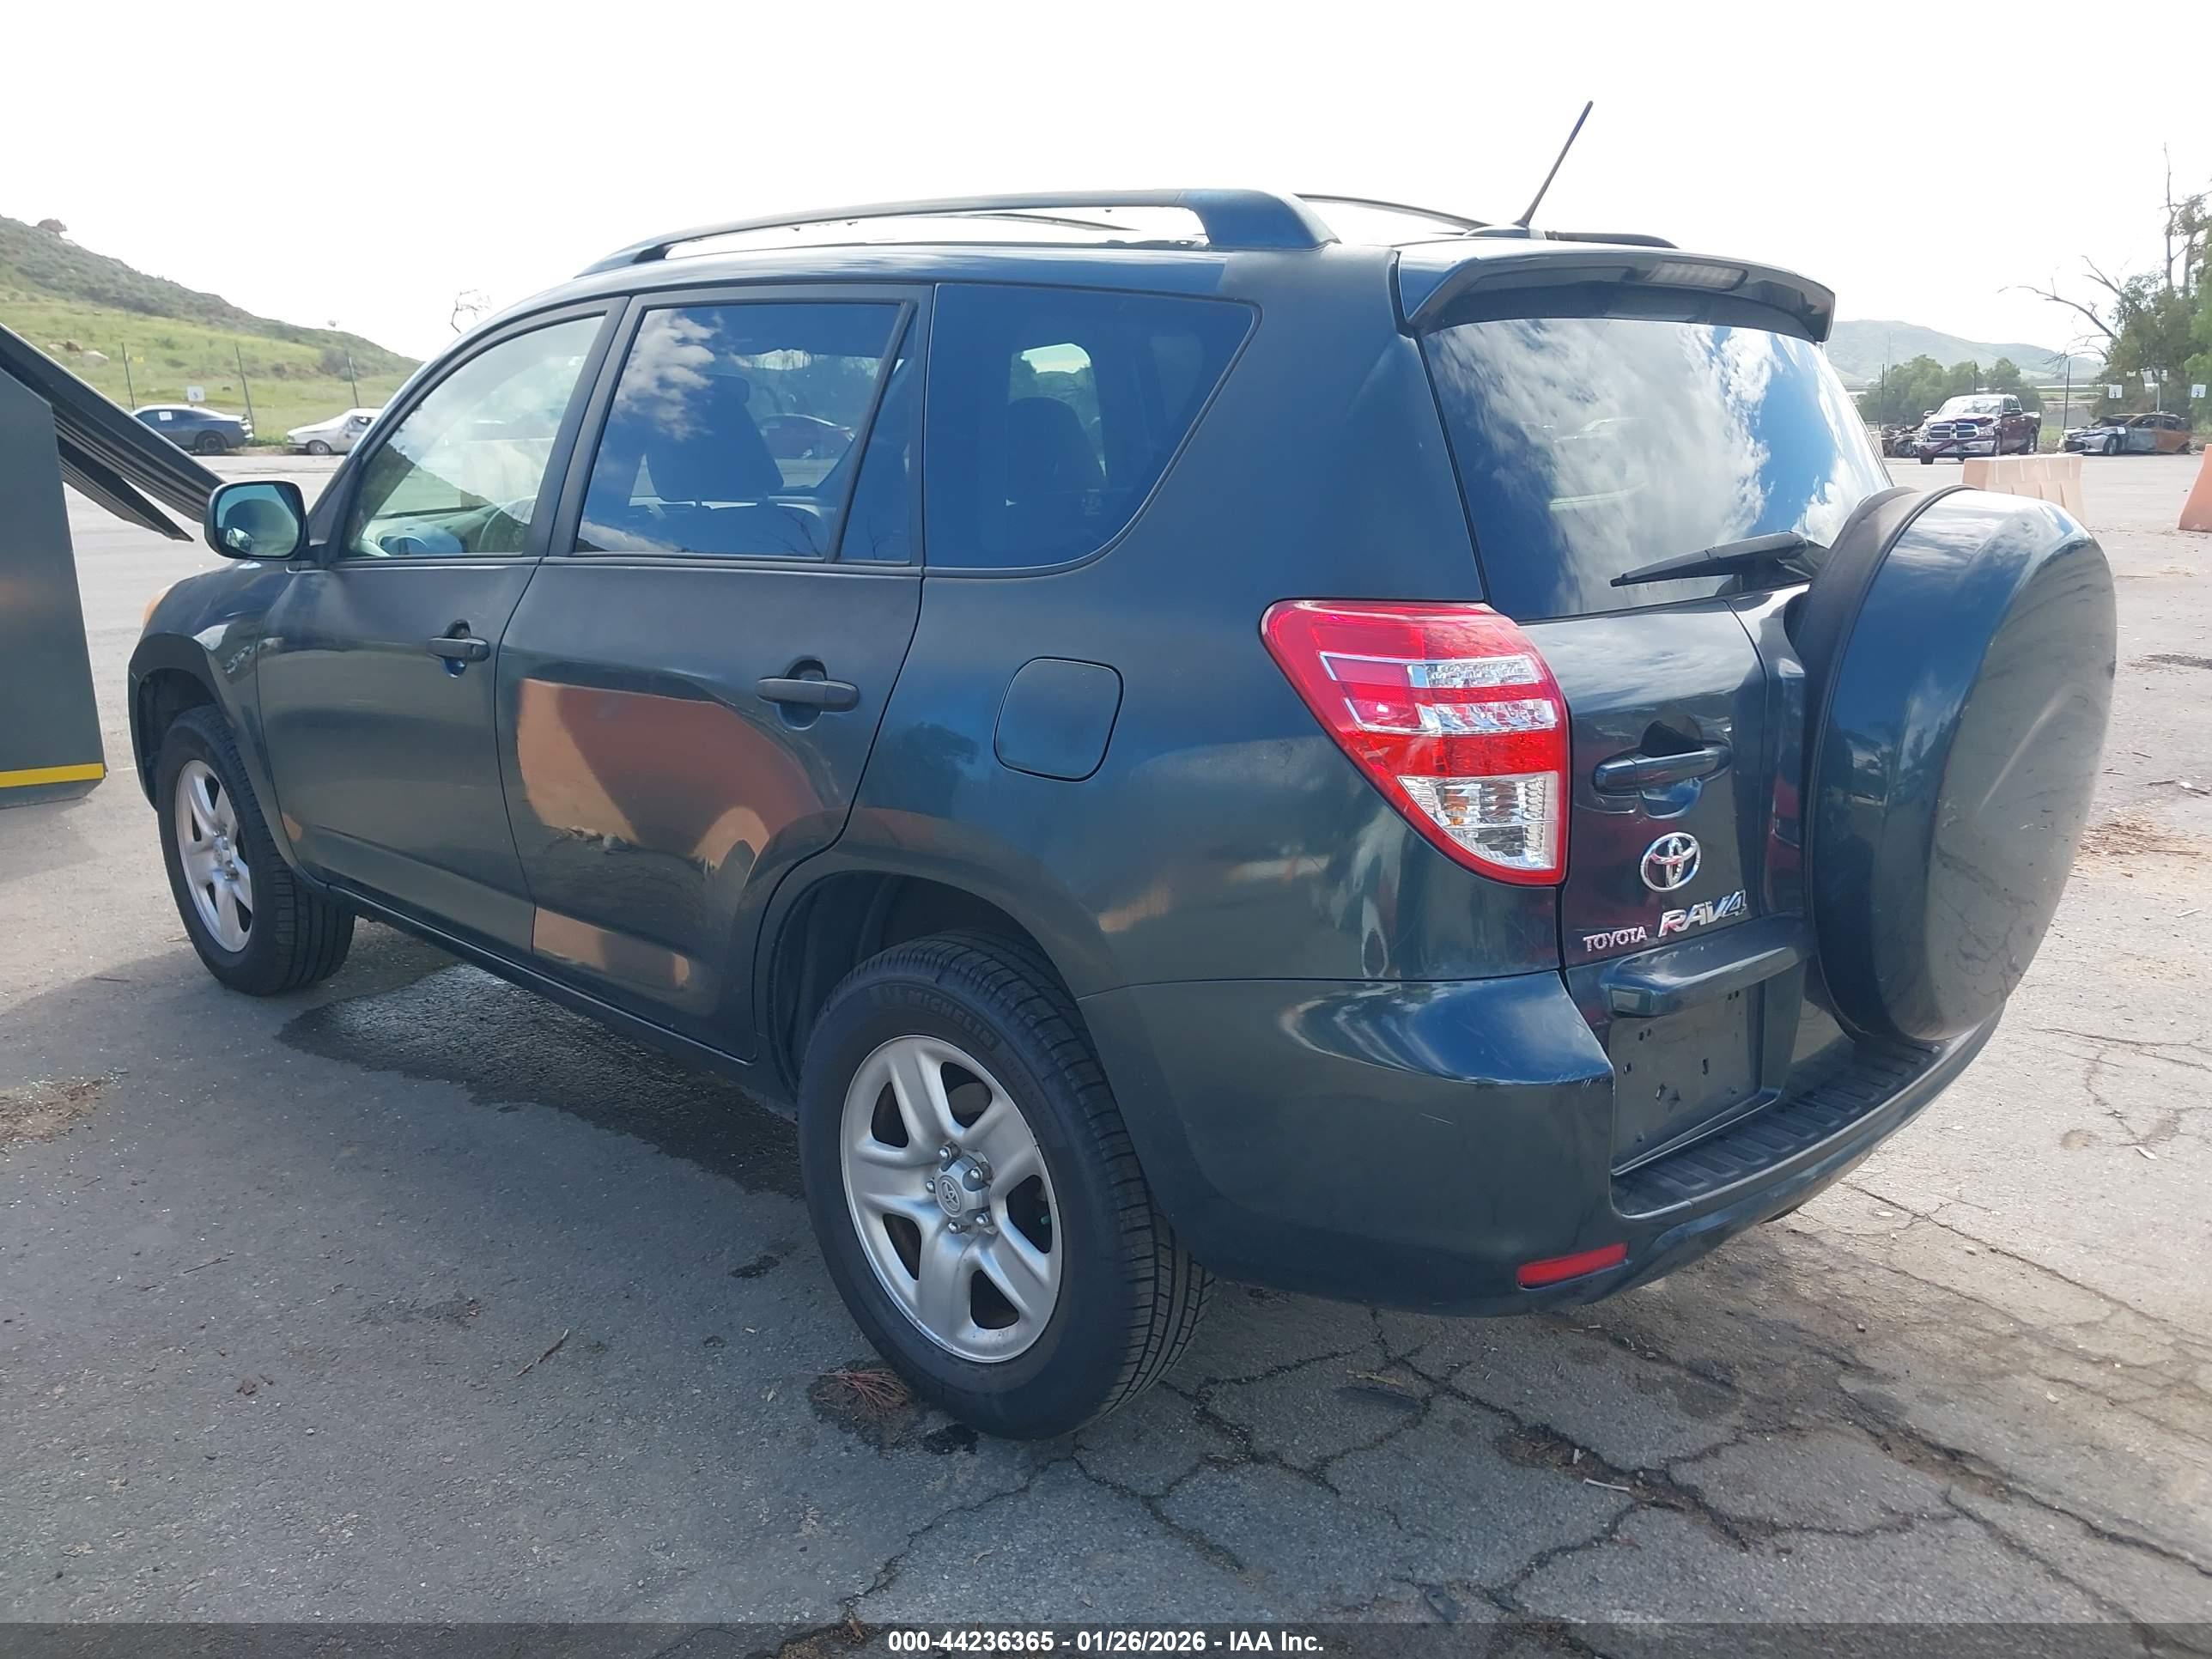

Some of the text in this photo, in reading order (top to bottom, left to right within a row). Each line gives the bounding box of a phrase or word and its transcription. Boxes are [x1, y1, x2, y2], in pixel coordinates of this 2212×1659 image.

[1583, 889, 1747, 952] TOYOTA RAV4
[908, 989, 995, 1048] MICHELIN
